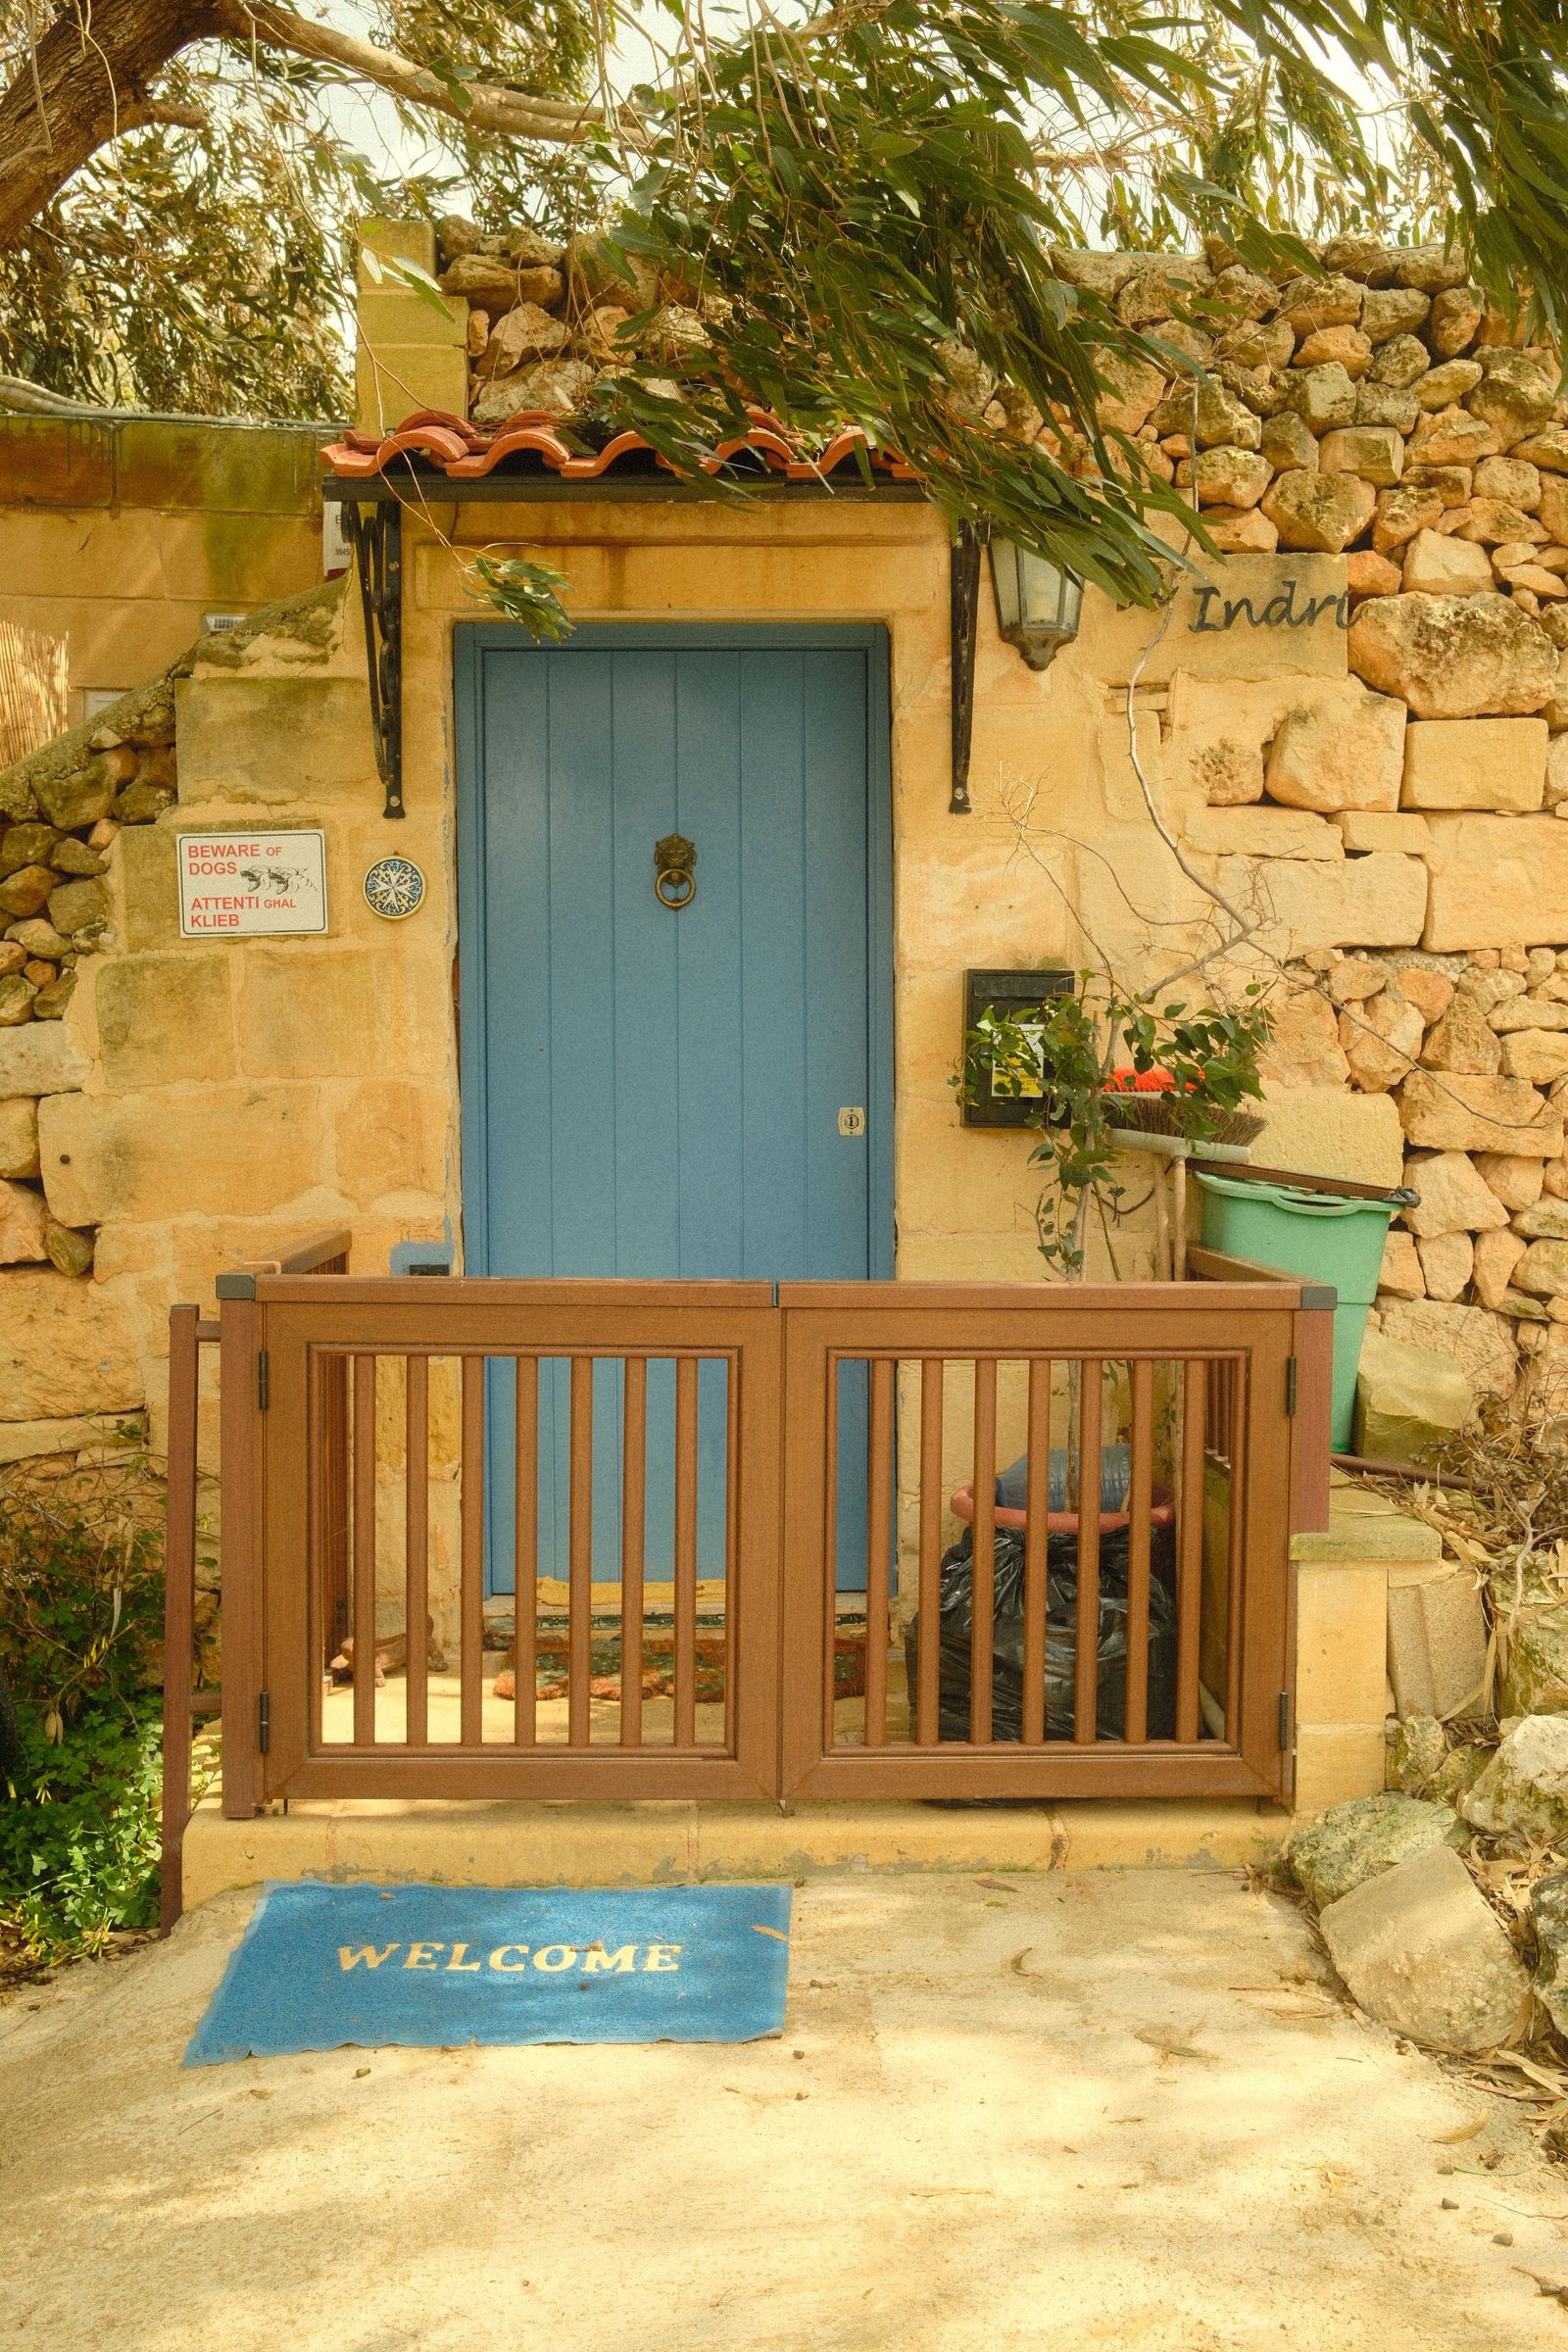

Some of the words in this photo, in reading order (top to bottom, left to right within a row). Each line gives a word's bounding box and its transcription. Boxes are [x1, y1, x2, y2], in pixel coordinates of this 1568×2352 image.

[1188, 580, 1363, 633] Indri
[187, 844, 261, 858] BEWARE
[266, 846, 283, 857] OF
[189, 861, 237, 875] DOGS
[190, 896, 260, 910] ATTENTI
[190, 913, 240, 928] KLIEB
[337, 1941, 684, 1973] WELCOME
